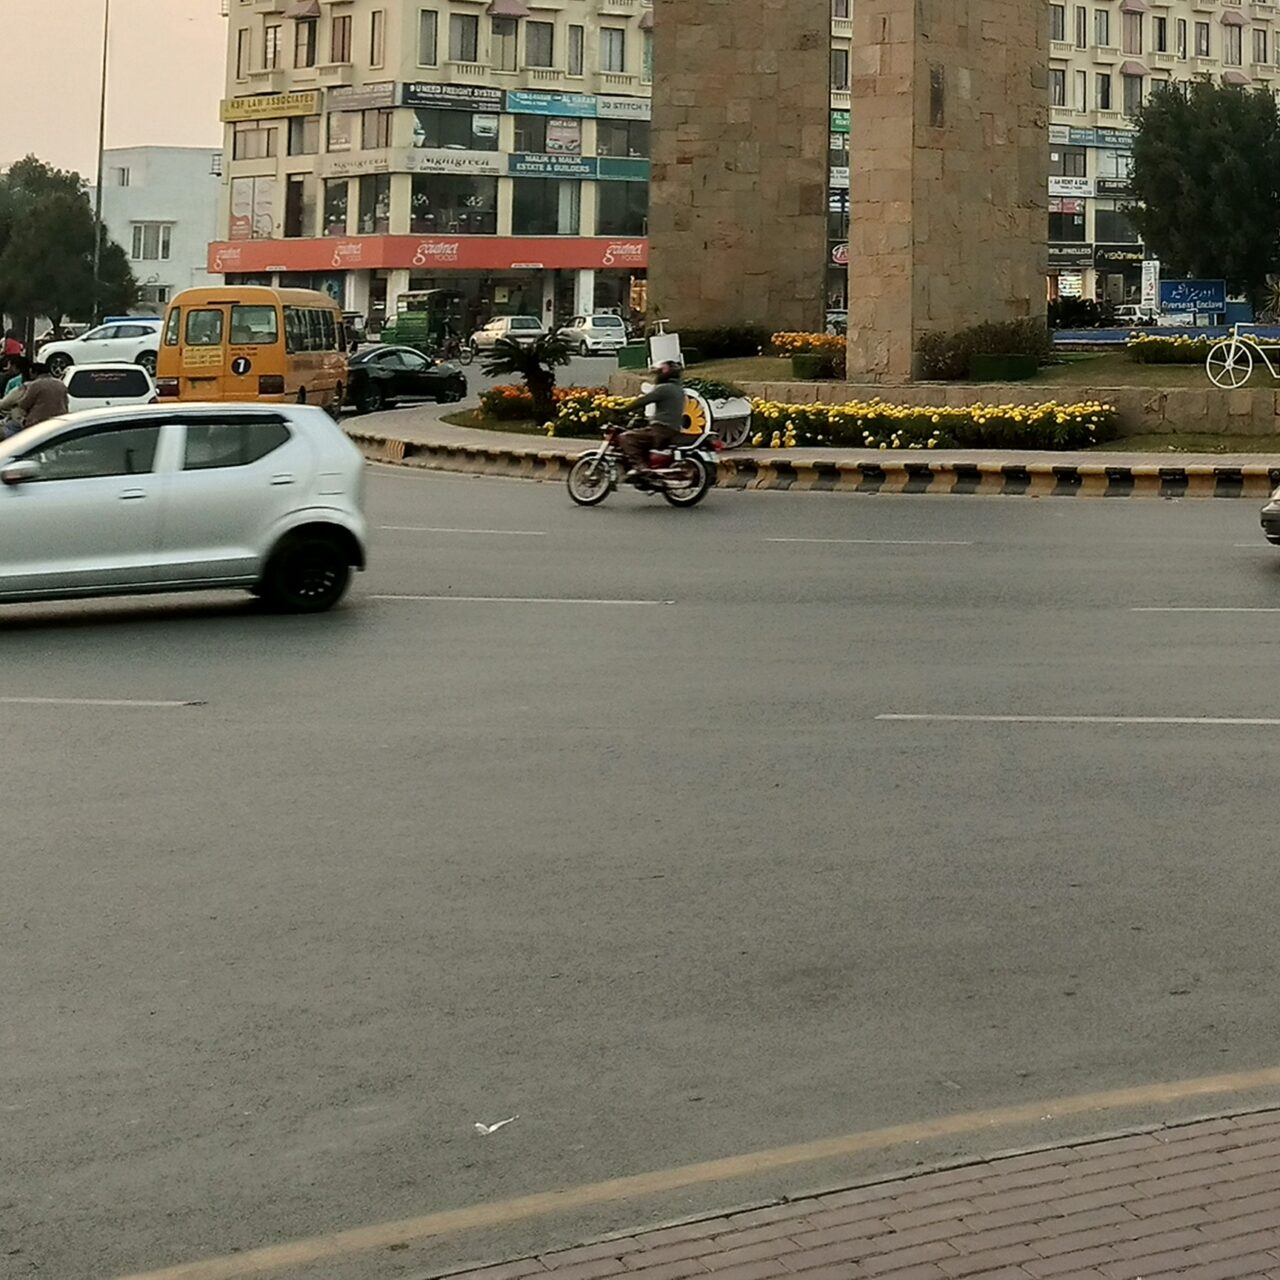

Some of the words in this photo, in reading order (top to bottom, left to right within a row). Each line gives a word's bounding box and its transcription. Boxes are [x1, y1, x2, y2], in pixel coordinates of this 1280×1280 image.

[266, 93, 315, 107] ASSOCIATES
[525, 155, 549, 163] MALIK
[516, 163, 544, 171] ESTATE
[554, 164, 590, 173] BUILDERS
[1196, 300, 1223, 309] Enclave
